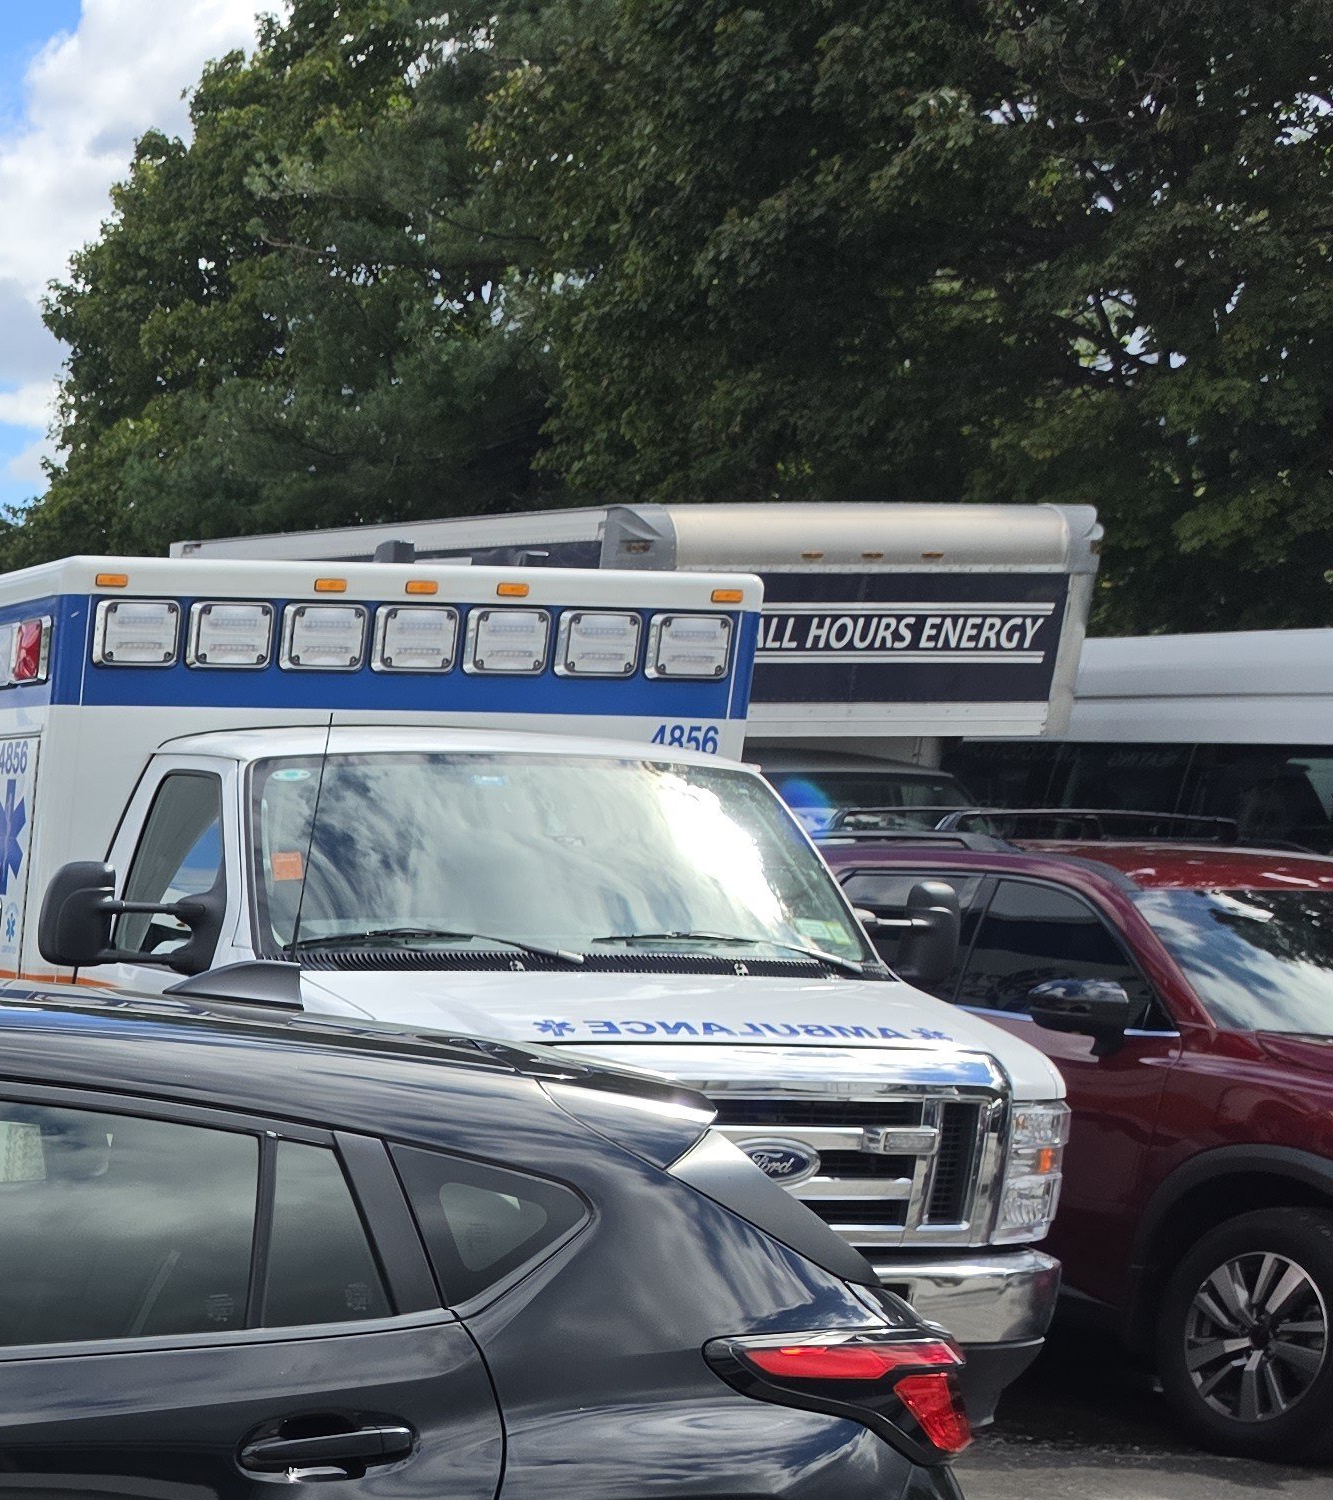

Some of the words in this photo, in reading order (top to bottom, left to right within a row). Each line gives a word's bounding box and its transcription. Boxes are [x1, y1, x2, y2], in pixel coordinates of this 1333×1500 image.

[805, 616, 912, 649] HOURS
[918, 616, 1044, 650] ENERGY
[651, 725, 719, 755] 4856
[752, 1151, 795, 1174] Ford
